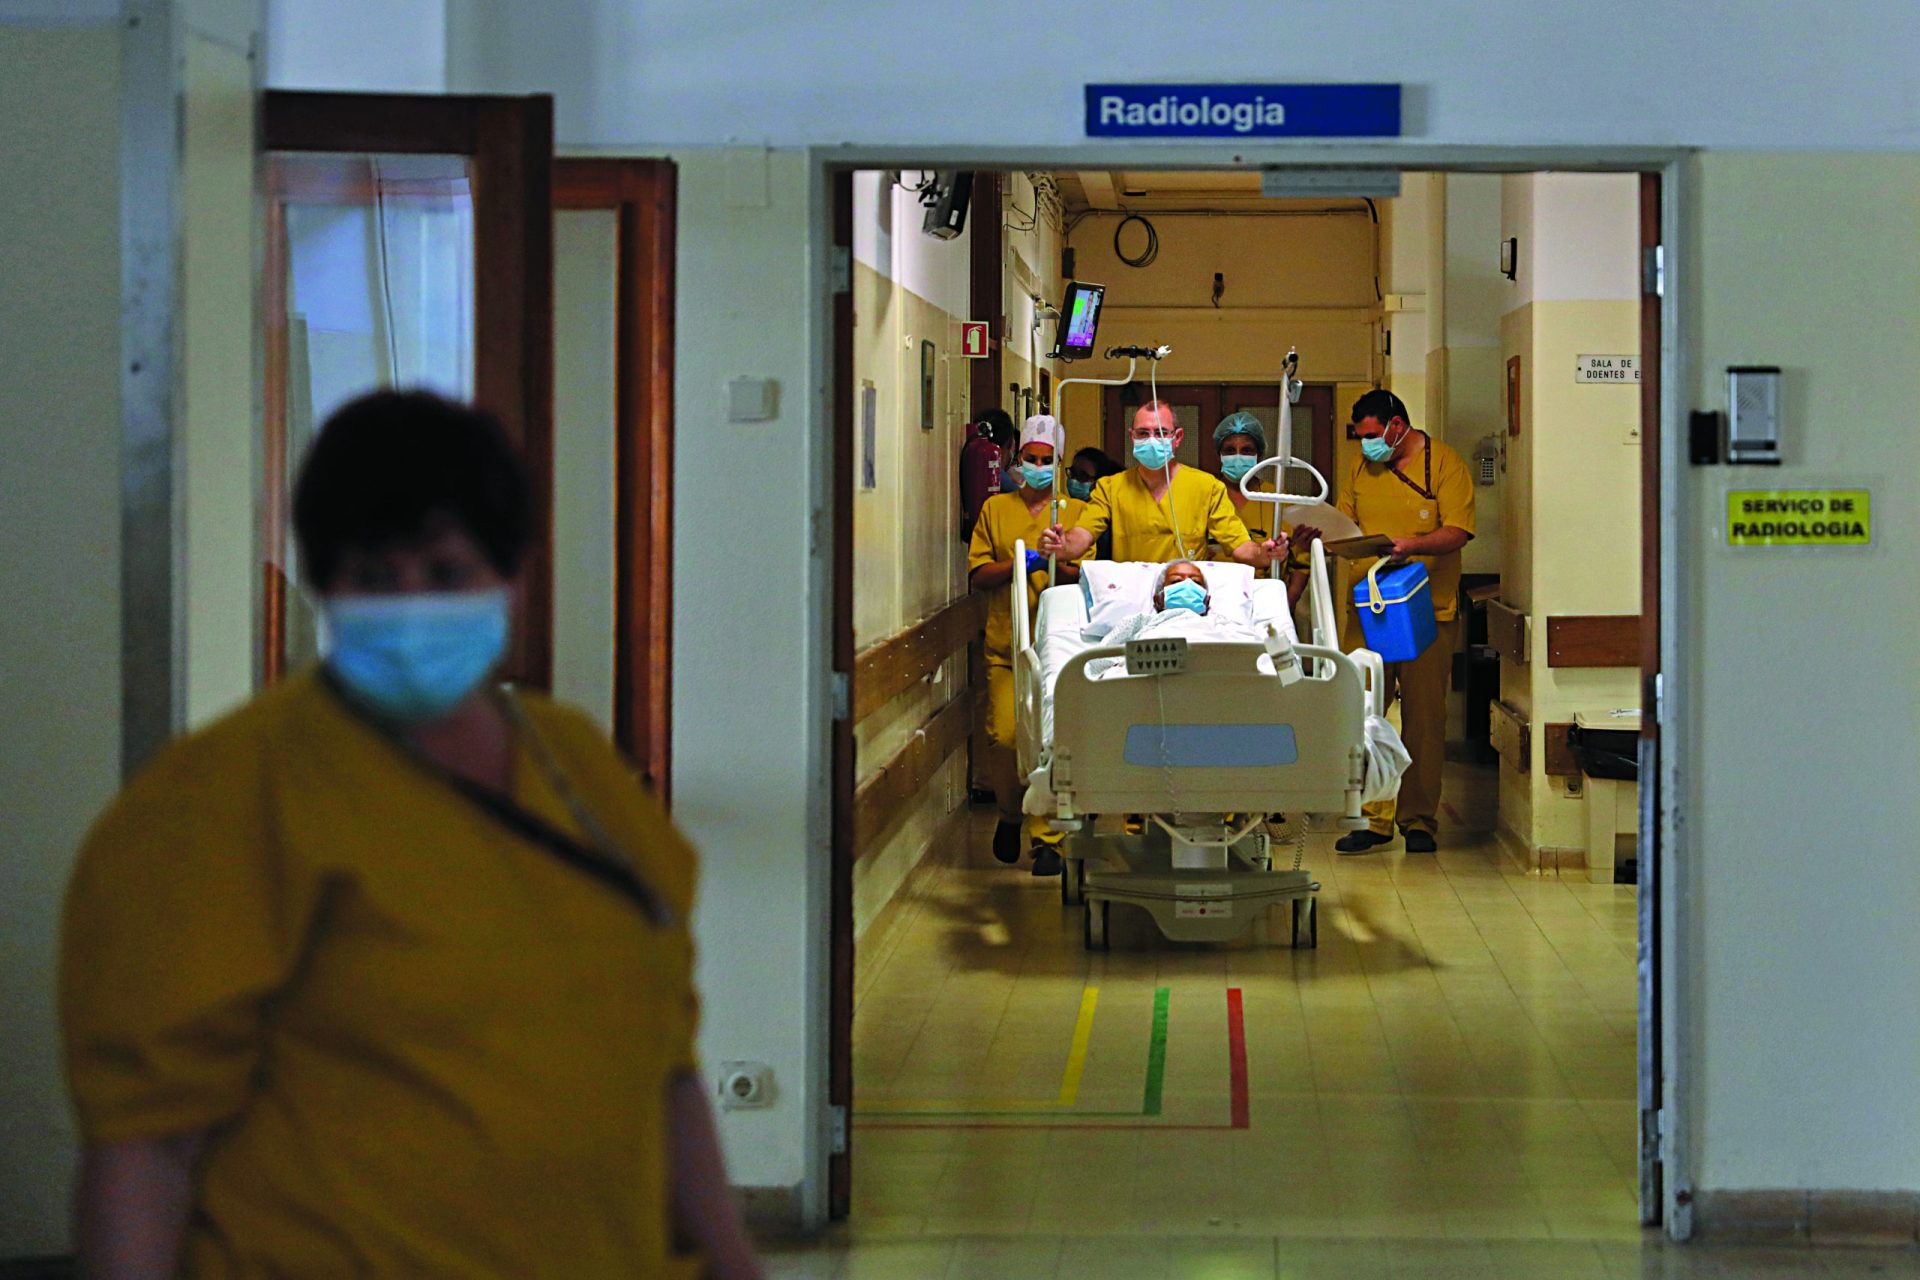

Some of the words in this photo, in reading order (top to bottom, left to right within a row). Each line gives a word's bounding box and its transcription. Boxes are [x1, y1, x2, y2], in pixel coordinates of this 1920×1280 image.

[1100, 96, 1285, 131] Radiologia
[1591, 359, 1612, 368] SALA
[1620, 359, 1632, 368] DE
[1586, 370, 1625, 379] DOENTES
[1743, 499, 1824, 515] SERVIÇO
[1829, 499, 1854, 512] DE
[1733, 521, 1865, 537] RADIOLOGIA
